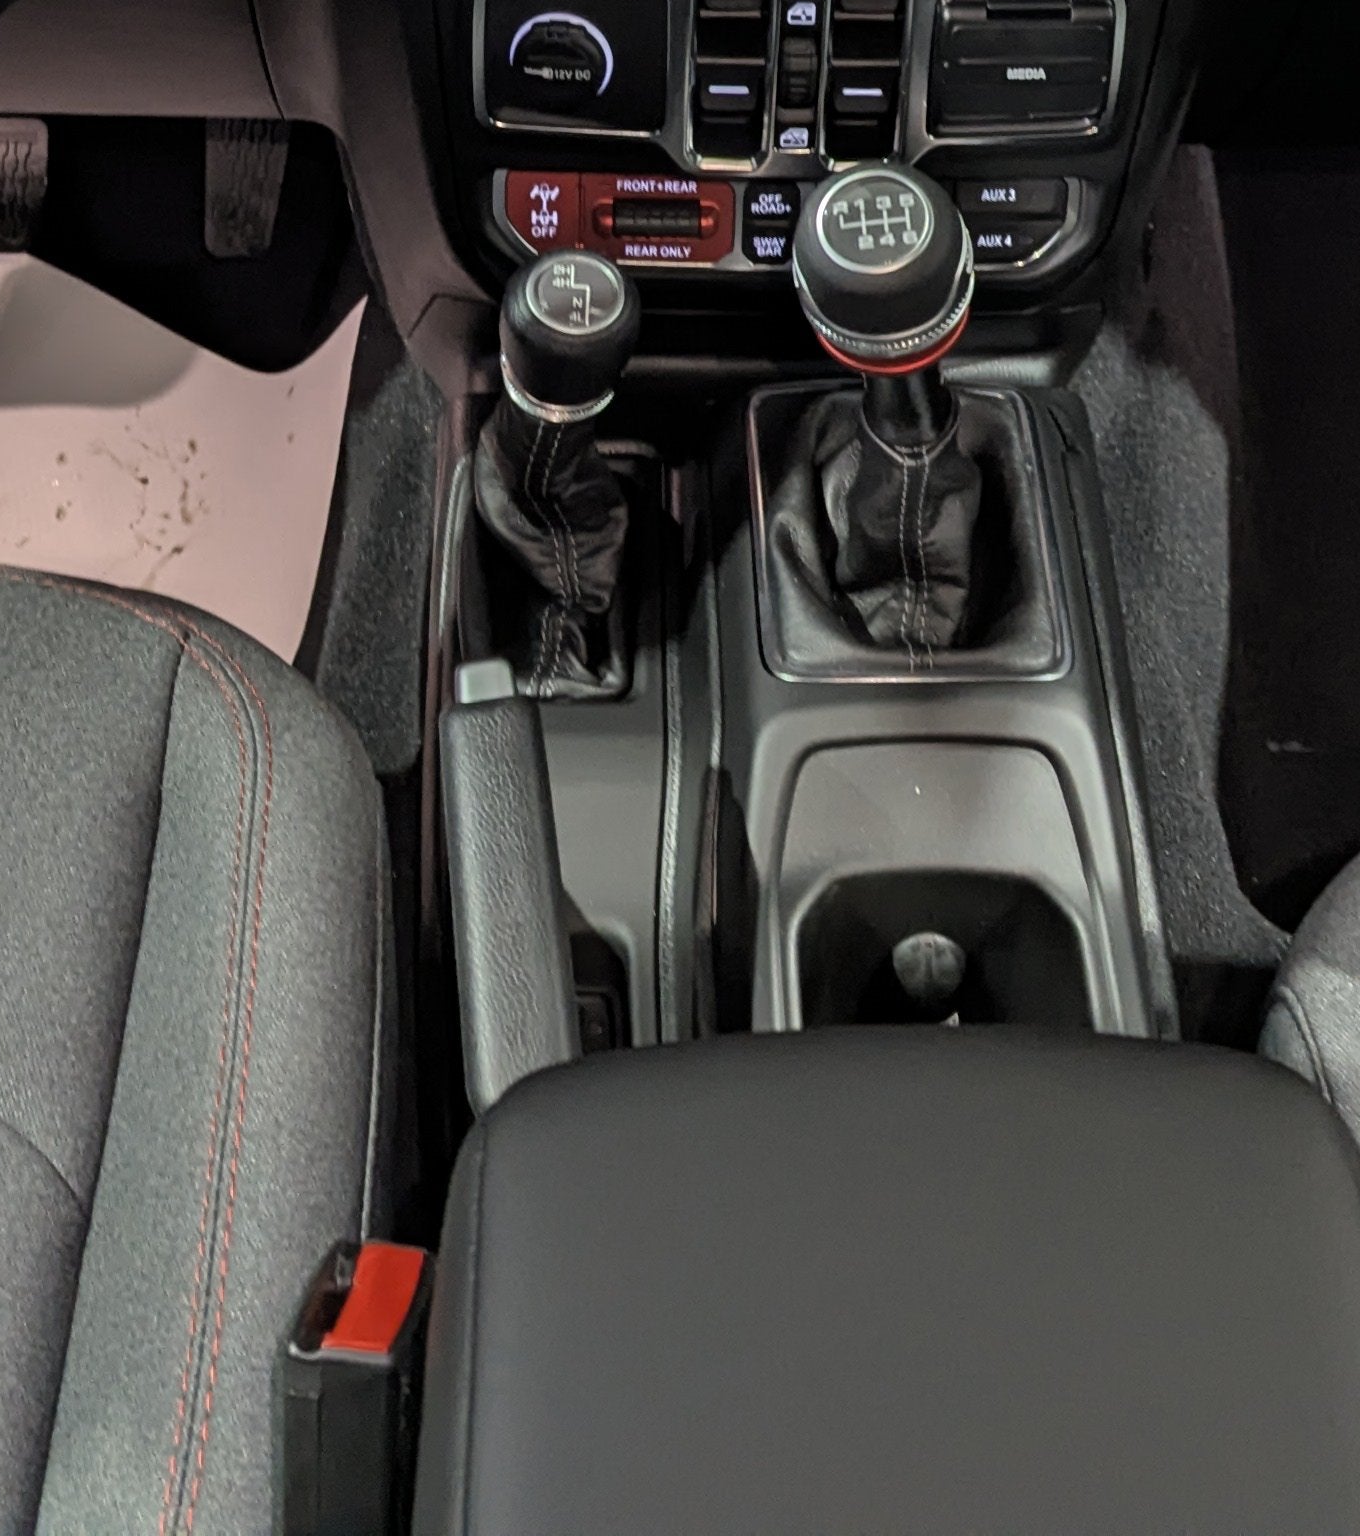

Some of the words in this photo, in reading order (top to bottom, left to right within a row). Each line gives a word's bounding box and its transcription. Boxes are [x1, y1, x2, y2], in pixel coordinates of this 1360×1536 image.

[553, 68, 574, 81] 12V
[575, 69, 592, 81] DC
[1006, 66, 1047, 81] MEDIA
[758, 193, 783, 204] OFF
[980, 187, 1006, 202] AUX
[1006, 188, 1017, 202] 3
[750, 202, 791, 214] ROAD+
[832, 200, 849, 215] R
[875, 195, 892, 211] 3
[531, 226, 556, 239] OFF
[752, 235, 786, 249] SWAY
[977, 234, 1004, 248] AUX
[1004, 235, 1013, 247] 4
[624, 244, 657, 257] REAR
[659, 246, 692, 260] ONLY
[756, 246, 783, 257] BAR
[572, 295, 583, 309] N
